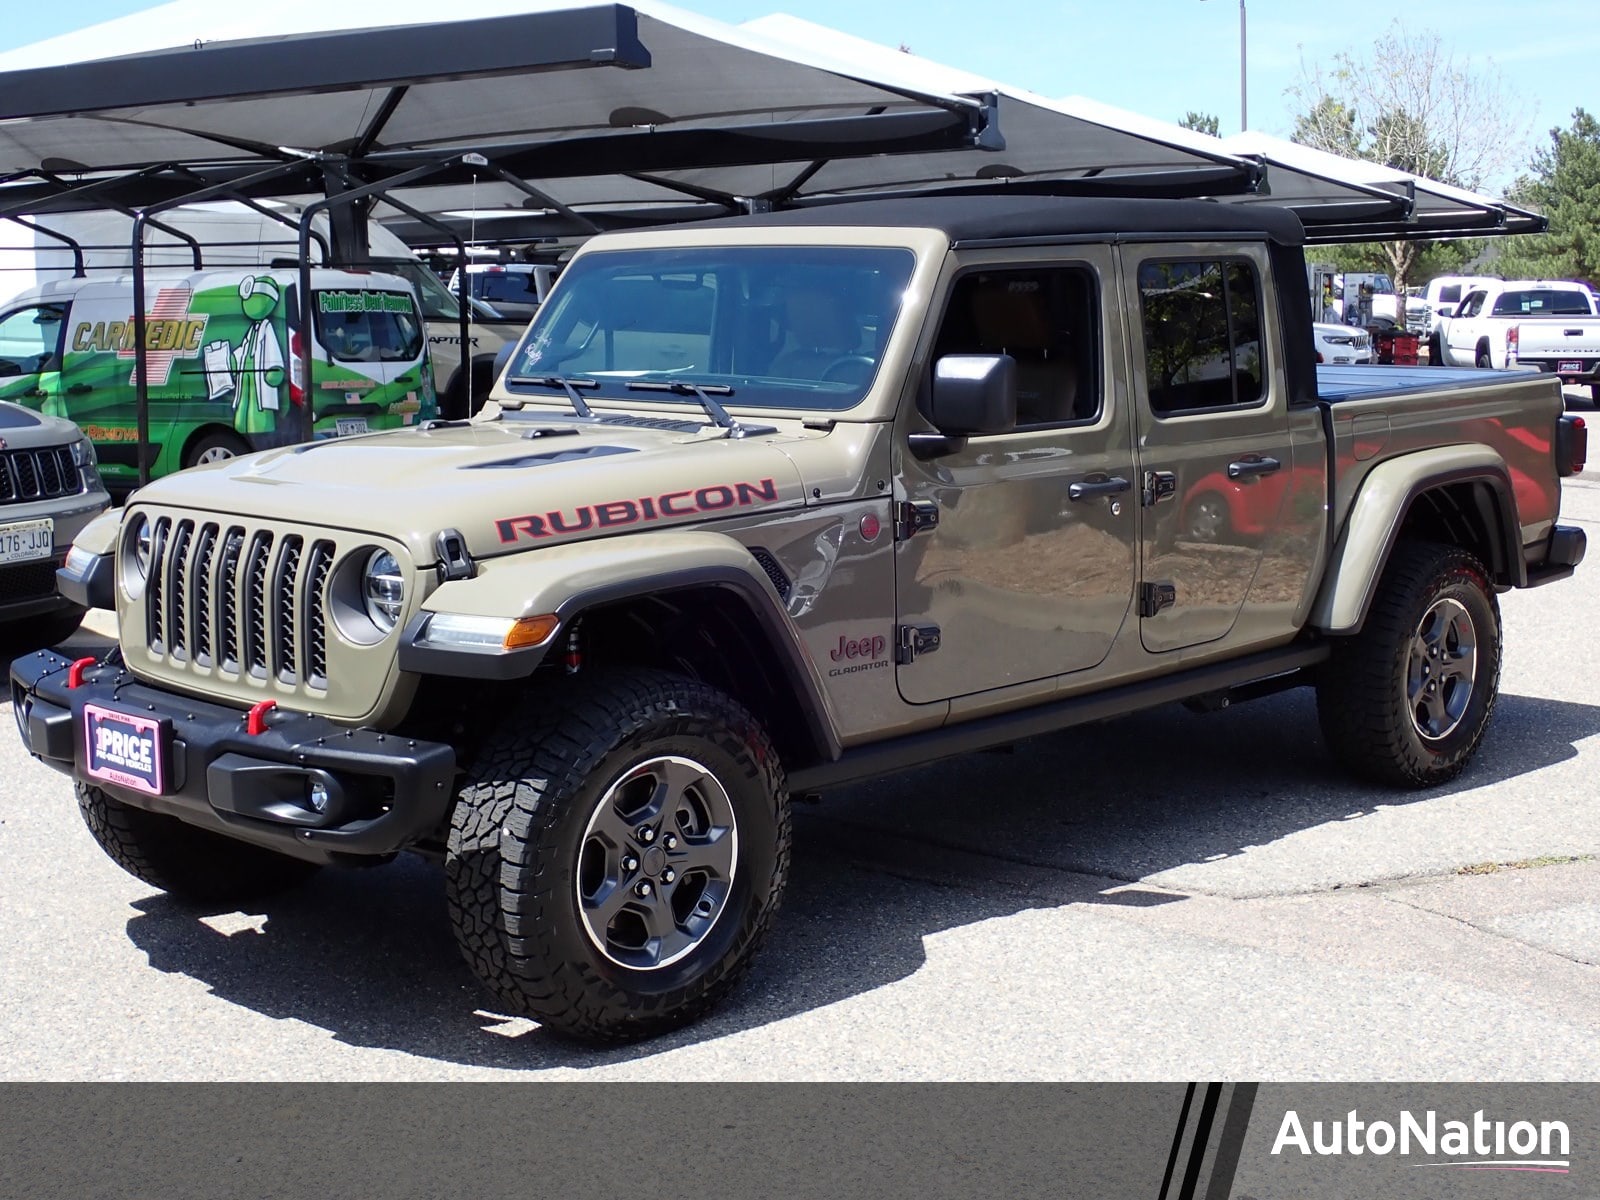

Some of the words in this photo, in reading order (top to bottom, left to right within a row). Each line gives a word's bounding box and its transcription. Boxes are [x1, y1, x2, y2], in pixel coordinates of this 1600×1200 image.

[428, 336, 479, 348] APTR
[495, 478, 779, 543] RUBICON
[829, 635, 887, 662] Jeep
[828, 660, 889, 677] GLADIATOR
